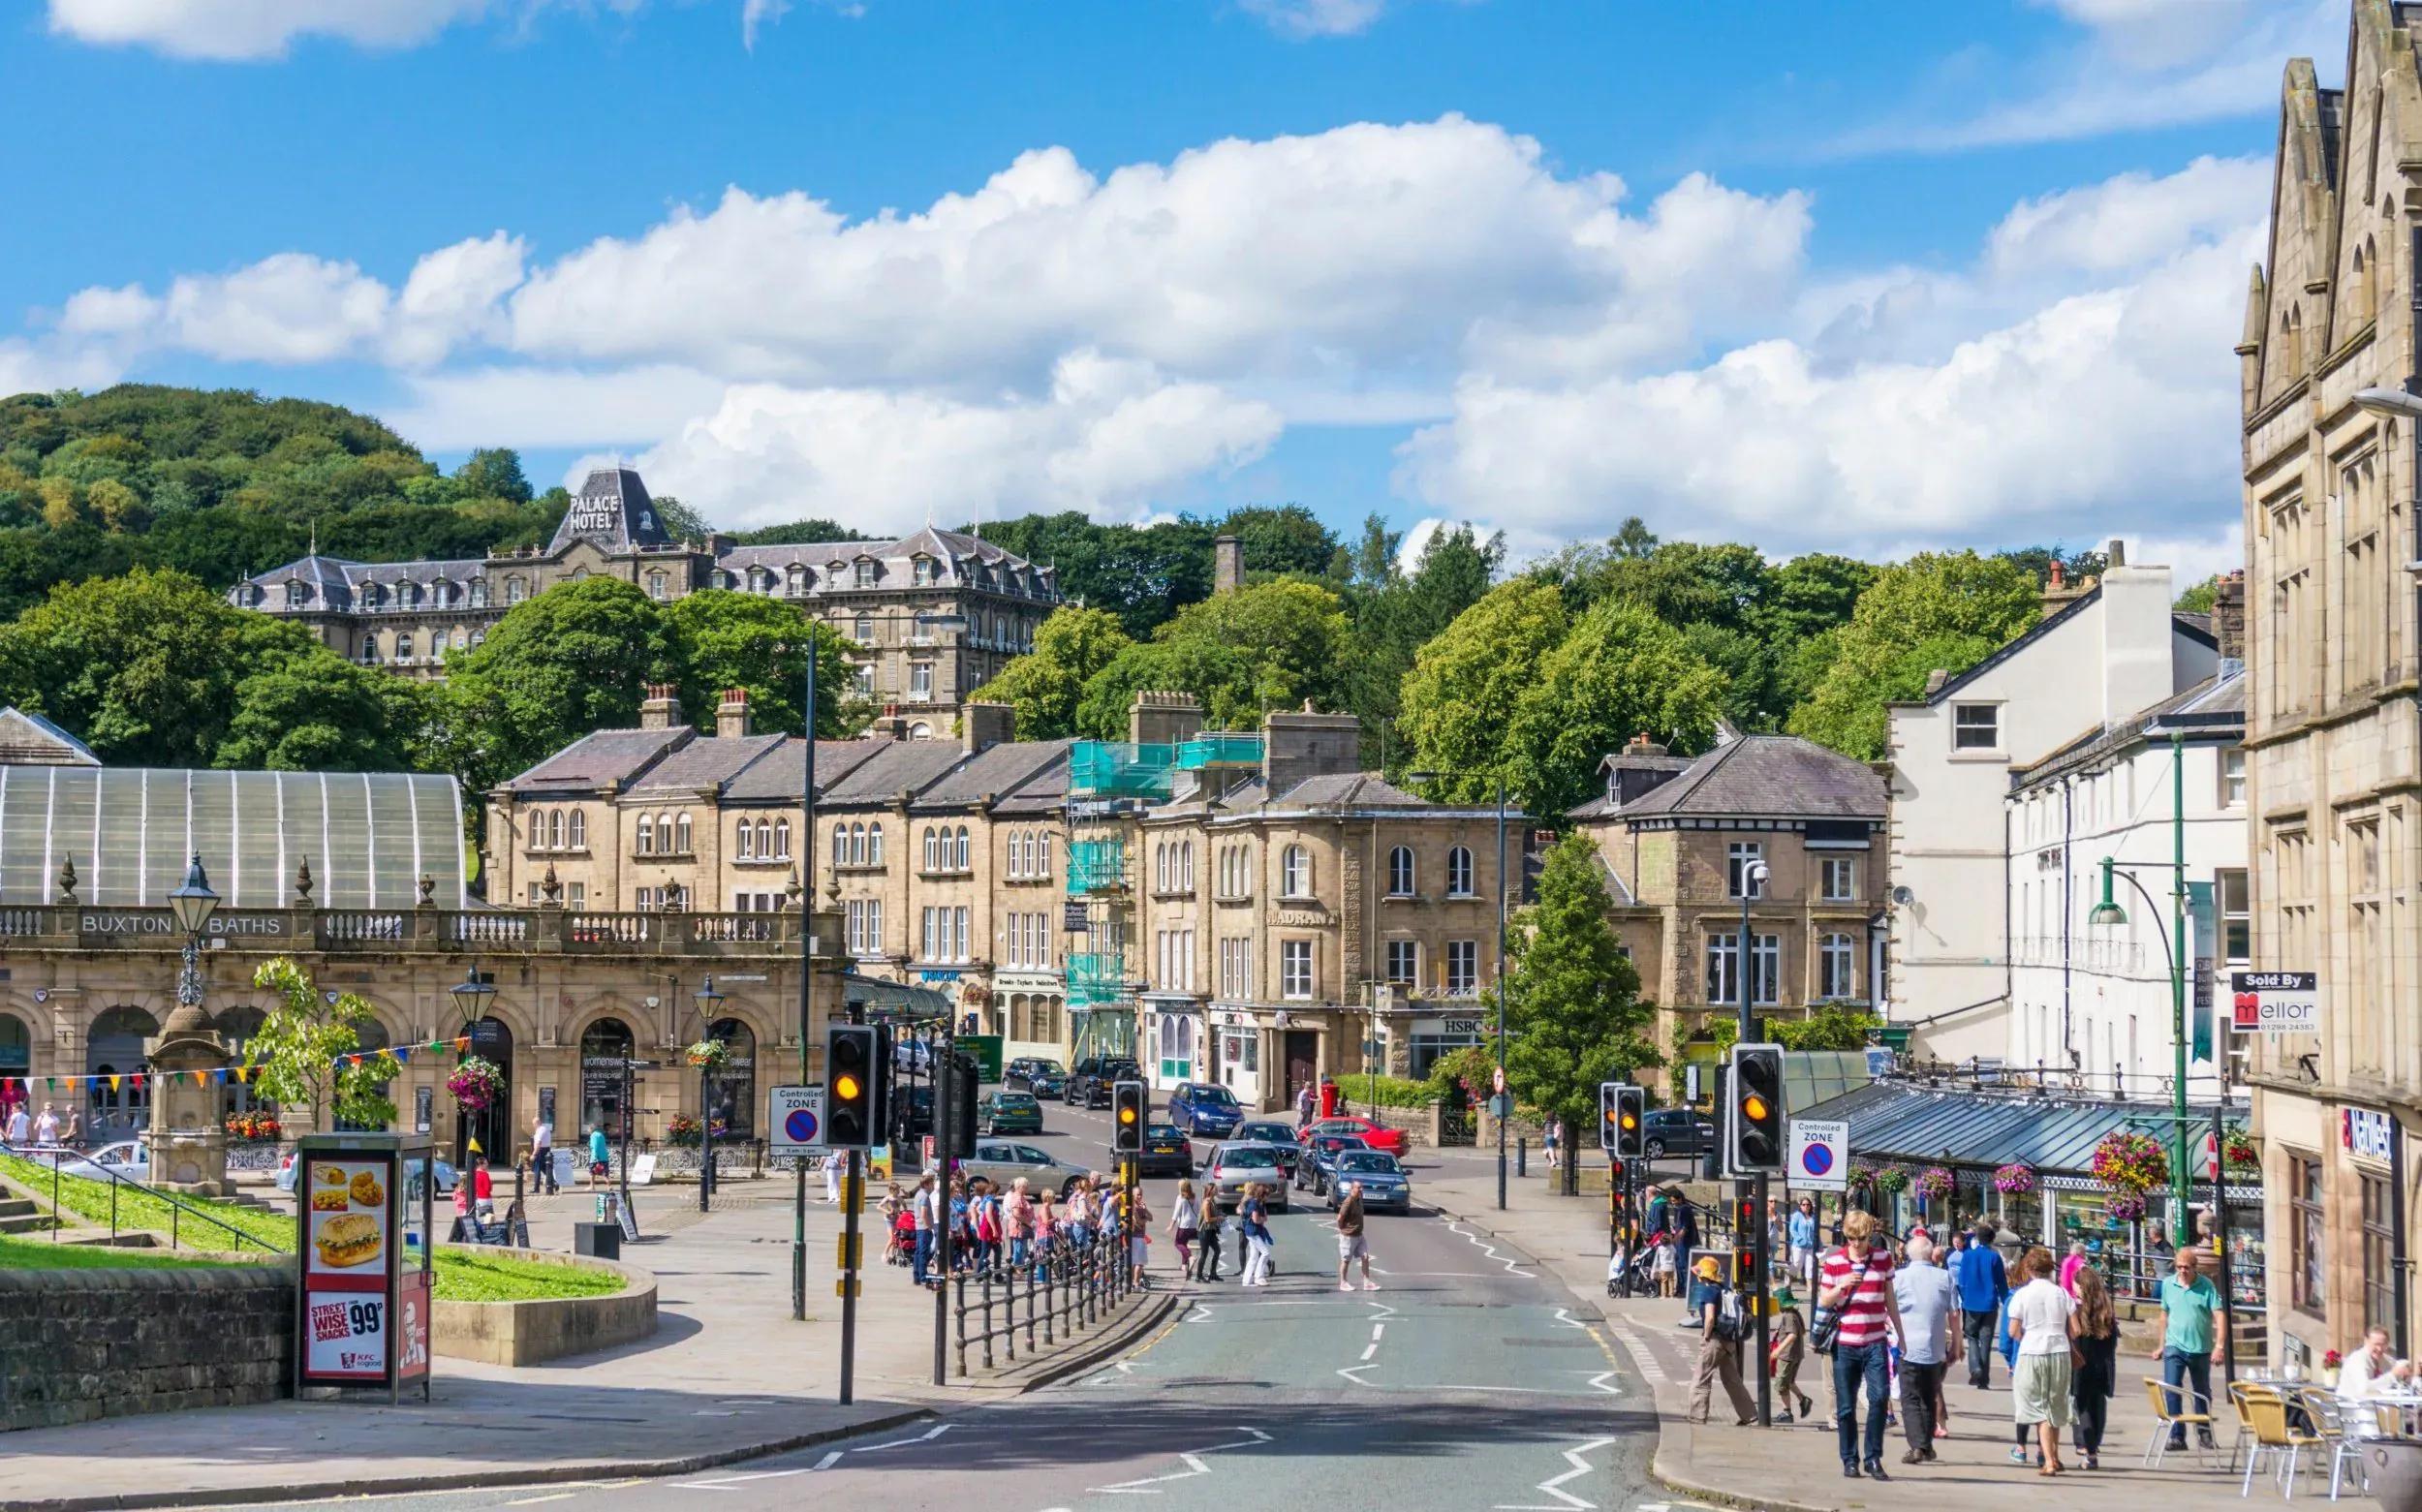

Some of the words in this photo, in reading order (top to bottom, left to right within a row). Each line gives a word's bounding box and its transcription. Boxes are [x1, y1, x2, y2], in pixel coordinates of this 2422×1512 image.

[570, 495, 618, 512] PALACE
[570, 512, 612, 530] HOTEL
[81, 916, 171, 933] BUXTON
[208, 917, 280, 934] BATHS
[928, 971, 961, 982] BARCLAYS
[2245, 974, 2279, 986] Sold
[2282, 974, 2302, 988] By
[2236, 1002, 2314, 1019] mellor
[1444, 1020, 1483, 1034] HSBC
[786, 1099, 817, 1108] ZONE
[1798, 1123, 1841, 1132] Controlled
[2351, 1107, 2391, 1160] NatWest
[1804, 1132, 1834, 1142] ZONE
[311, 1302, 347, 1318] STREET
[313, 1313, 349, 1333] WISE
[316, 1327, 351, 1342] SNACKS
